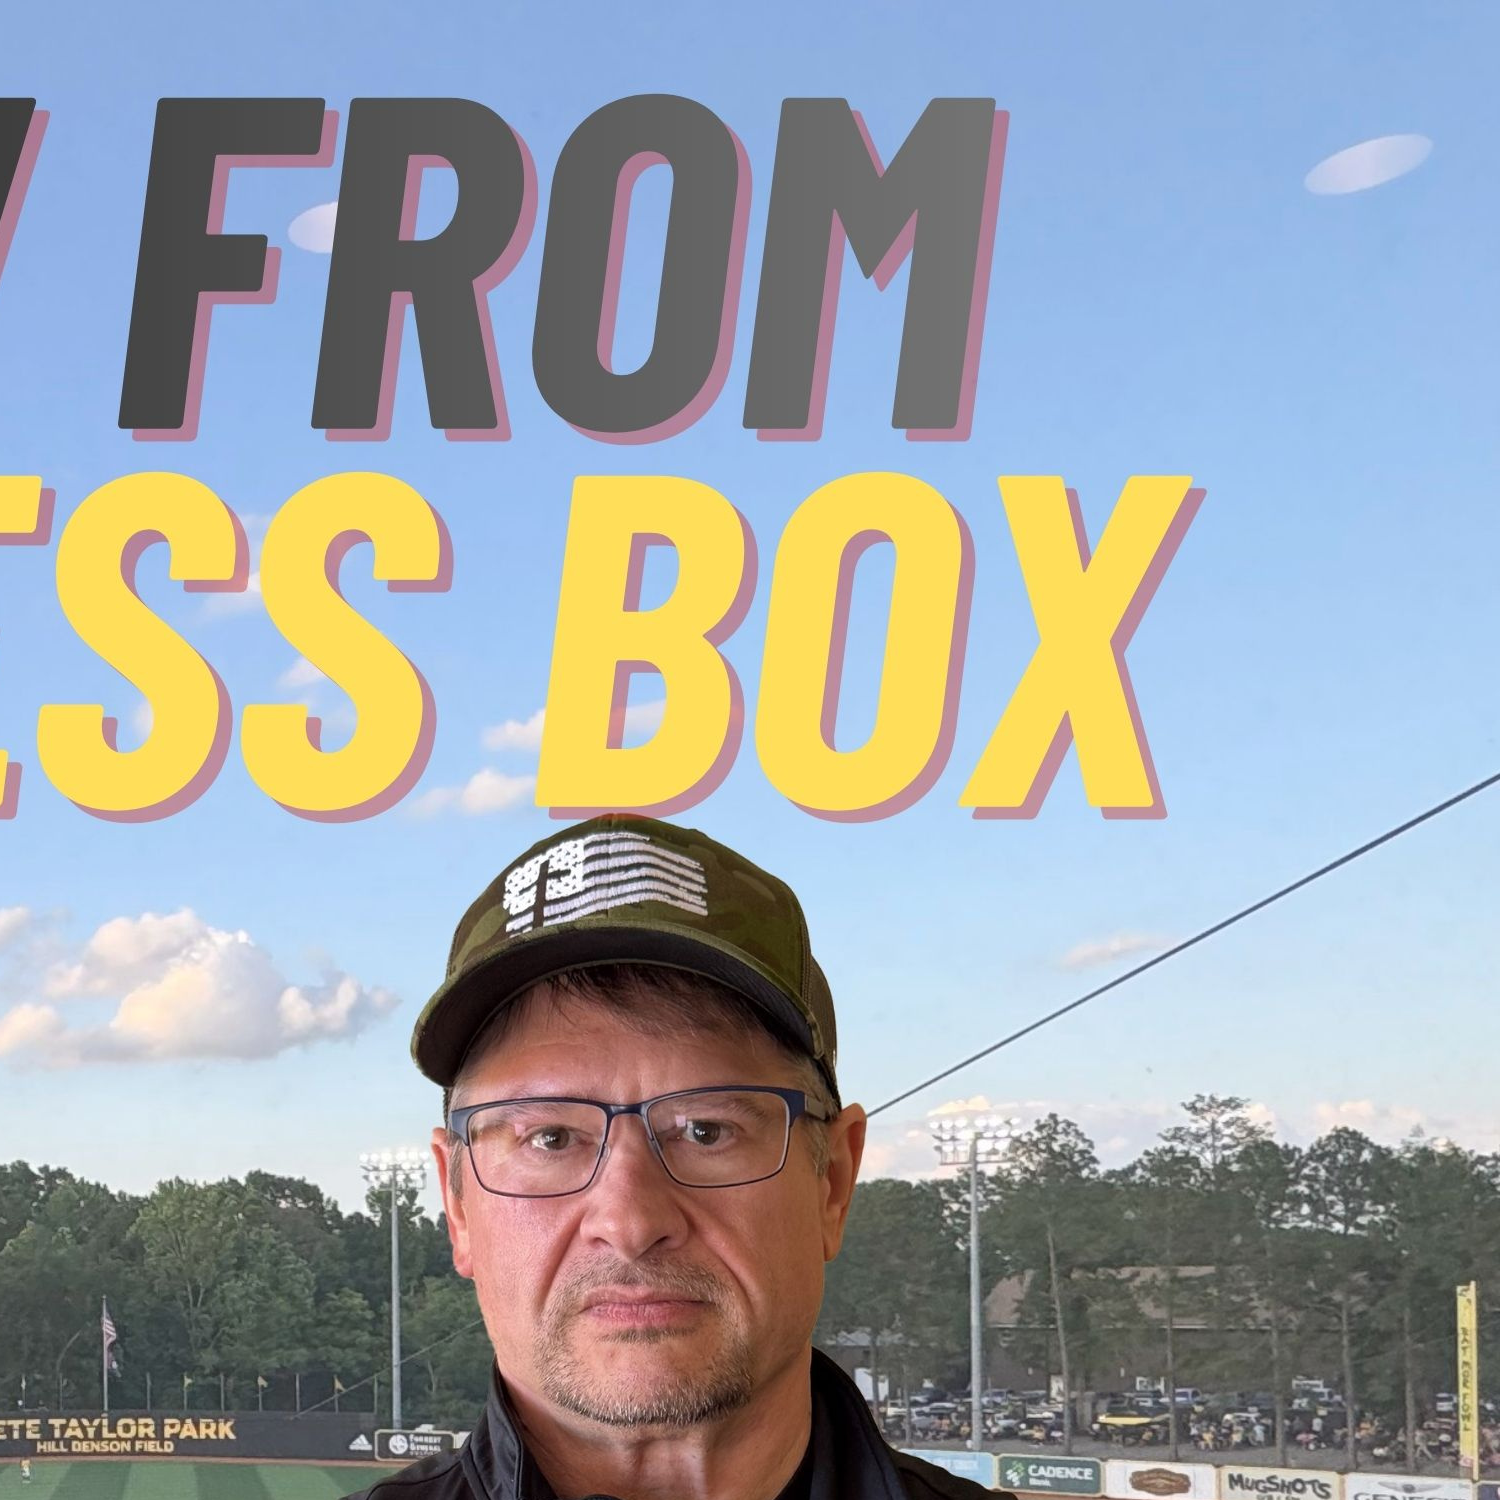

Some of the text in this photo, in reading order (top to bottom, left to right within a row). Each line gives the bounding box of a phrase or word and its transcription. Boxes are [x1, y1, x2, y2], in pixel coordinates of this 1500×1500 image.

[48, 1417, 155, 1439] TAYLOR
[164, 1418, 236, 1440] PARK
[37, 1441, 174, 1453] HILL DENSON FIELD
[1028, 1465, 1093, 1481] CADENCE
